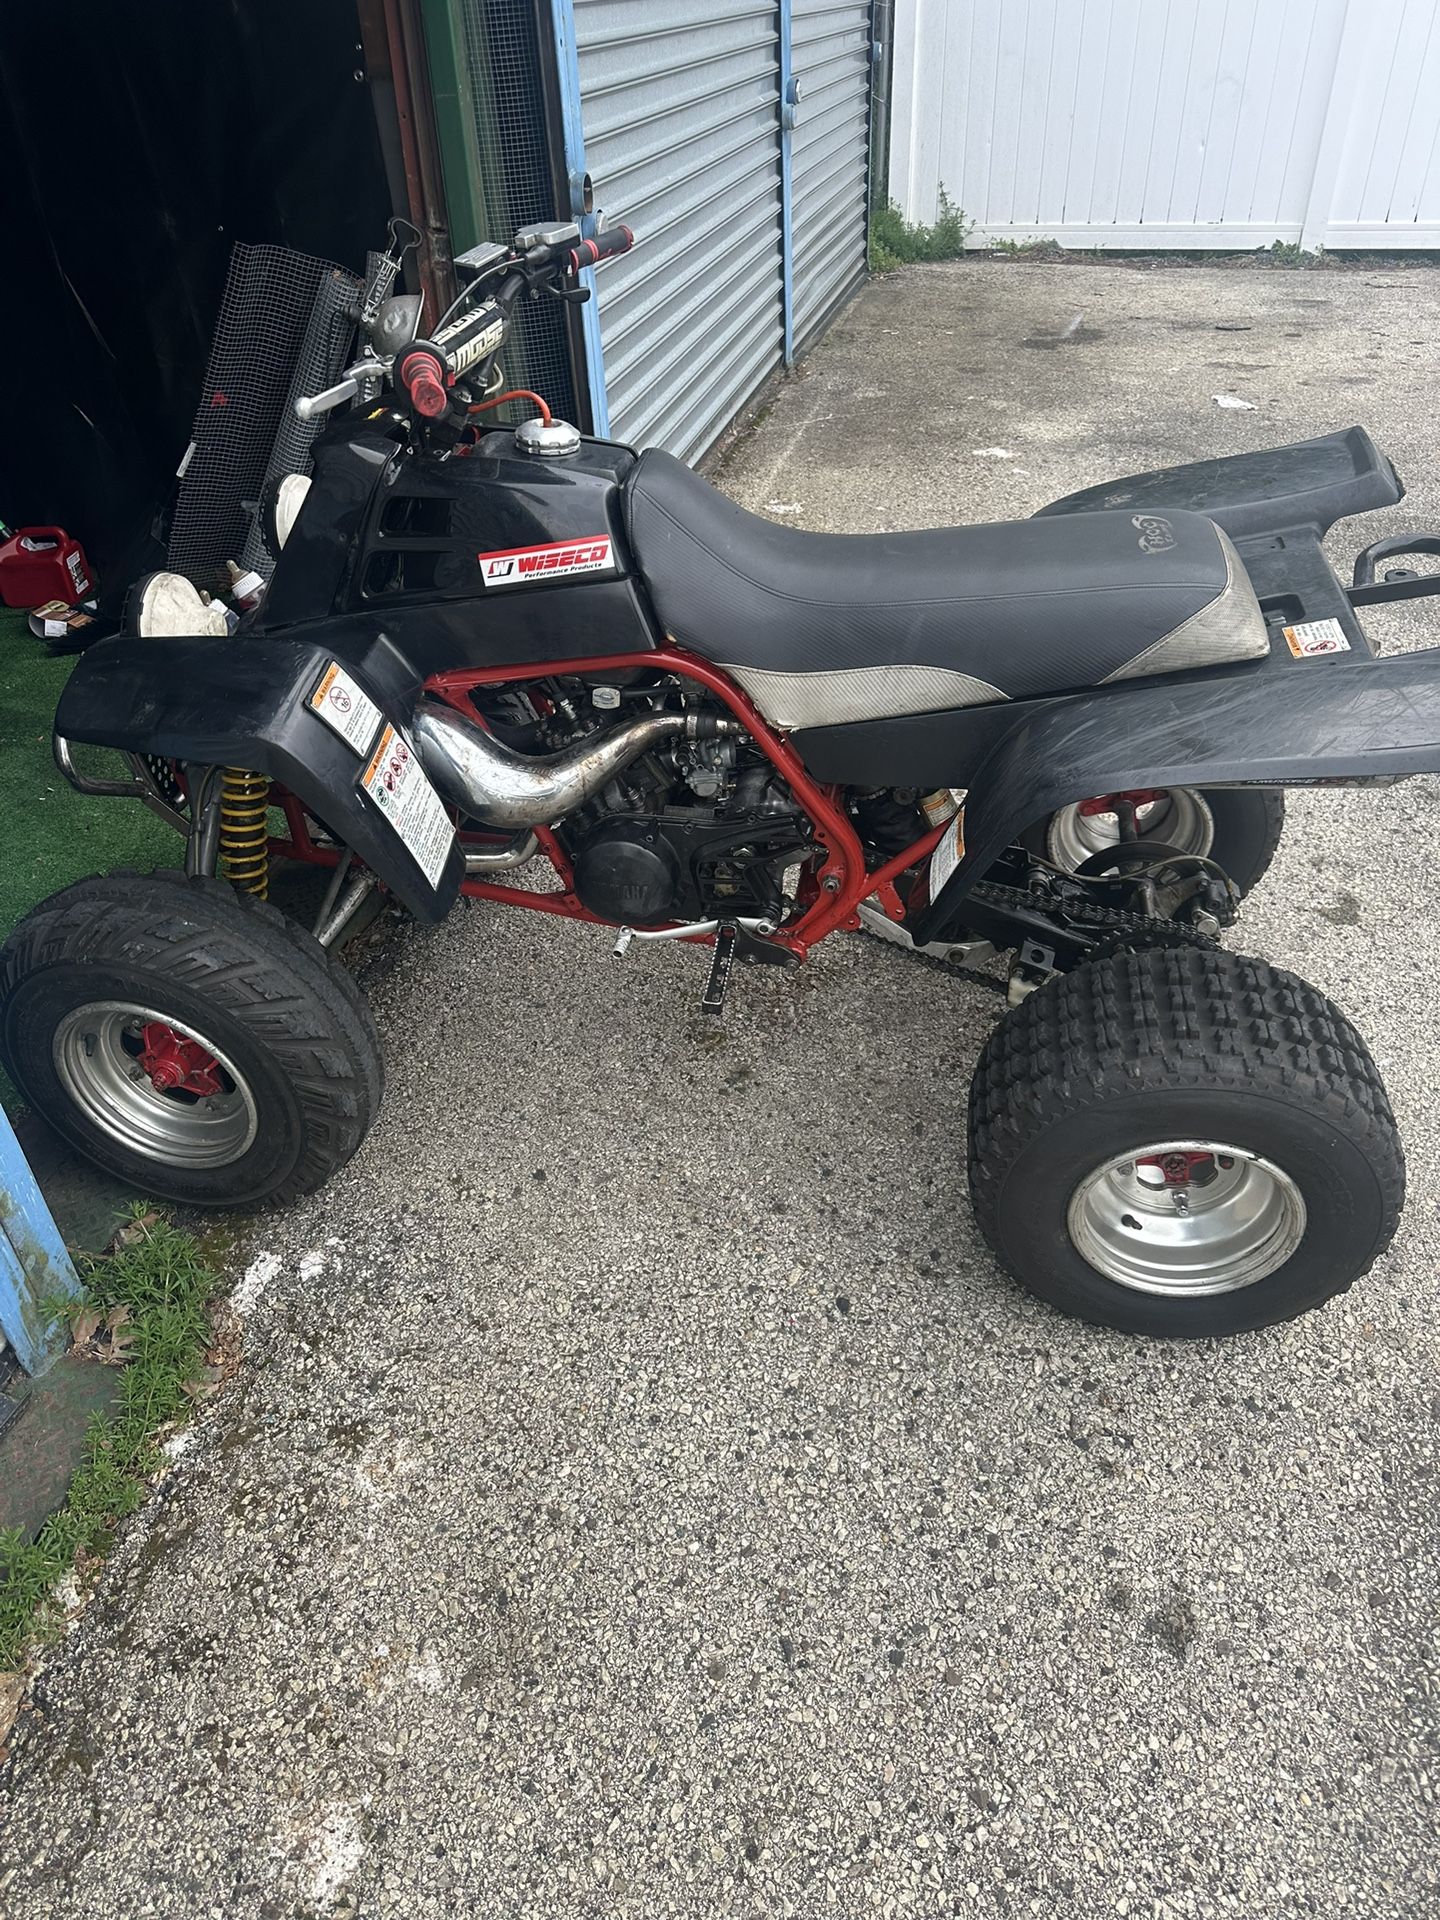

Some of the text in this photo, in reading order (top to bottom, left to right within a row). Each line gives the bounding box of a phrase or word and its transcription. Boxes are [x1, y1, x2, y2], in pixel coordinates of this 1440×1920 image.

[456, 317, 503, 372] MOOSE
[518, 544, 609, 573] WISECO
[524, 562, 602, 579] Performance Products
[341, 699, 349, 709] 16
